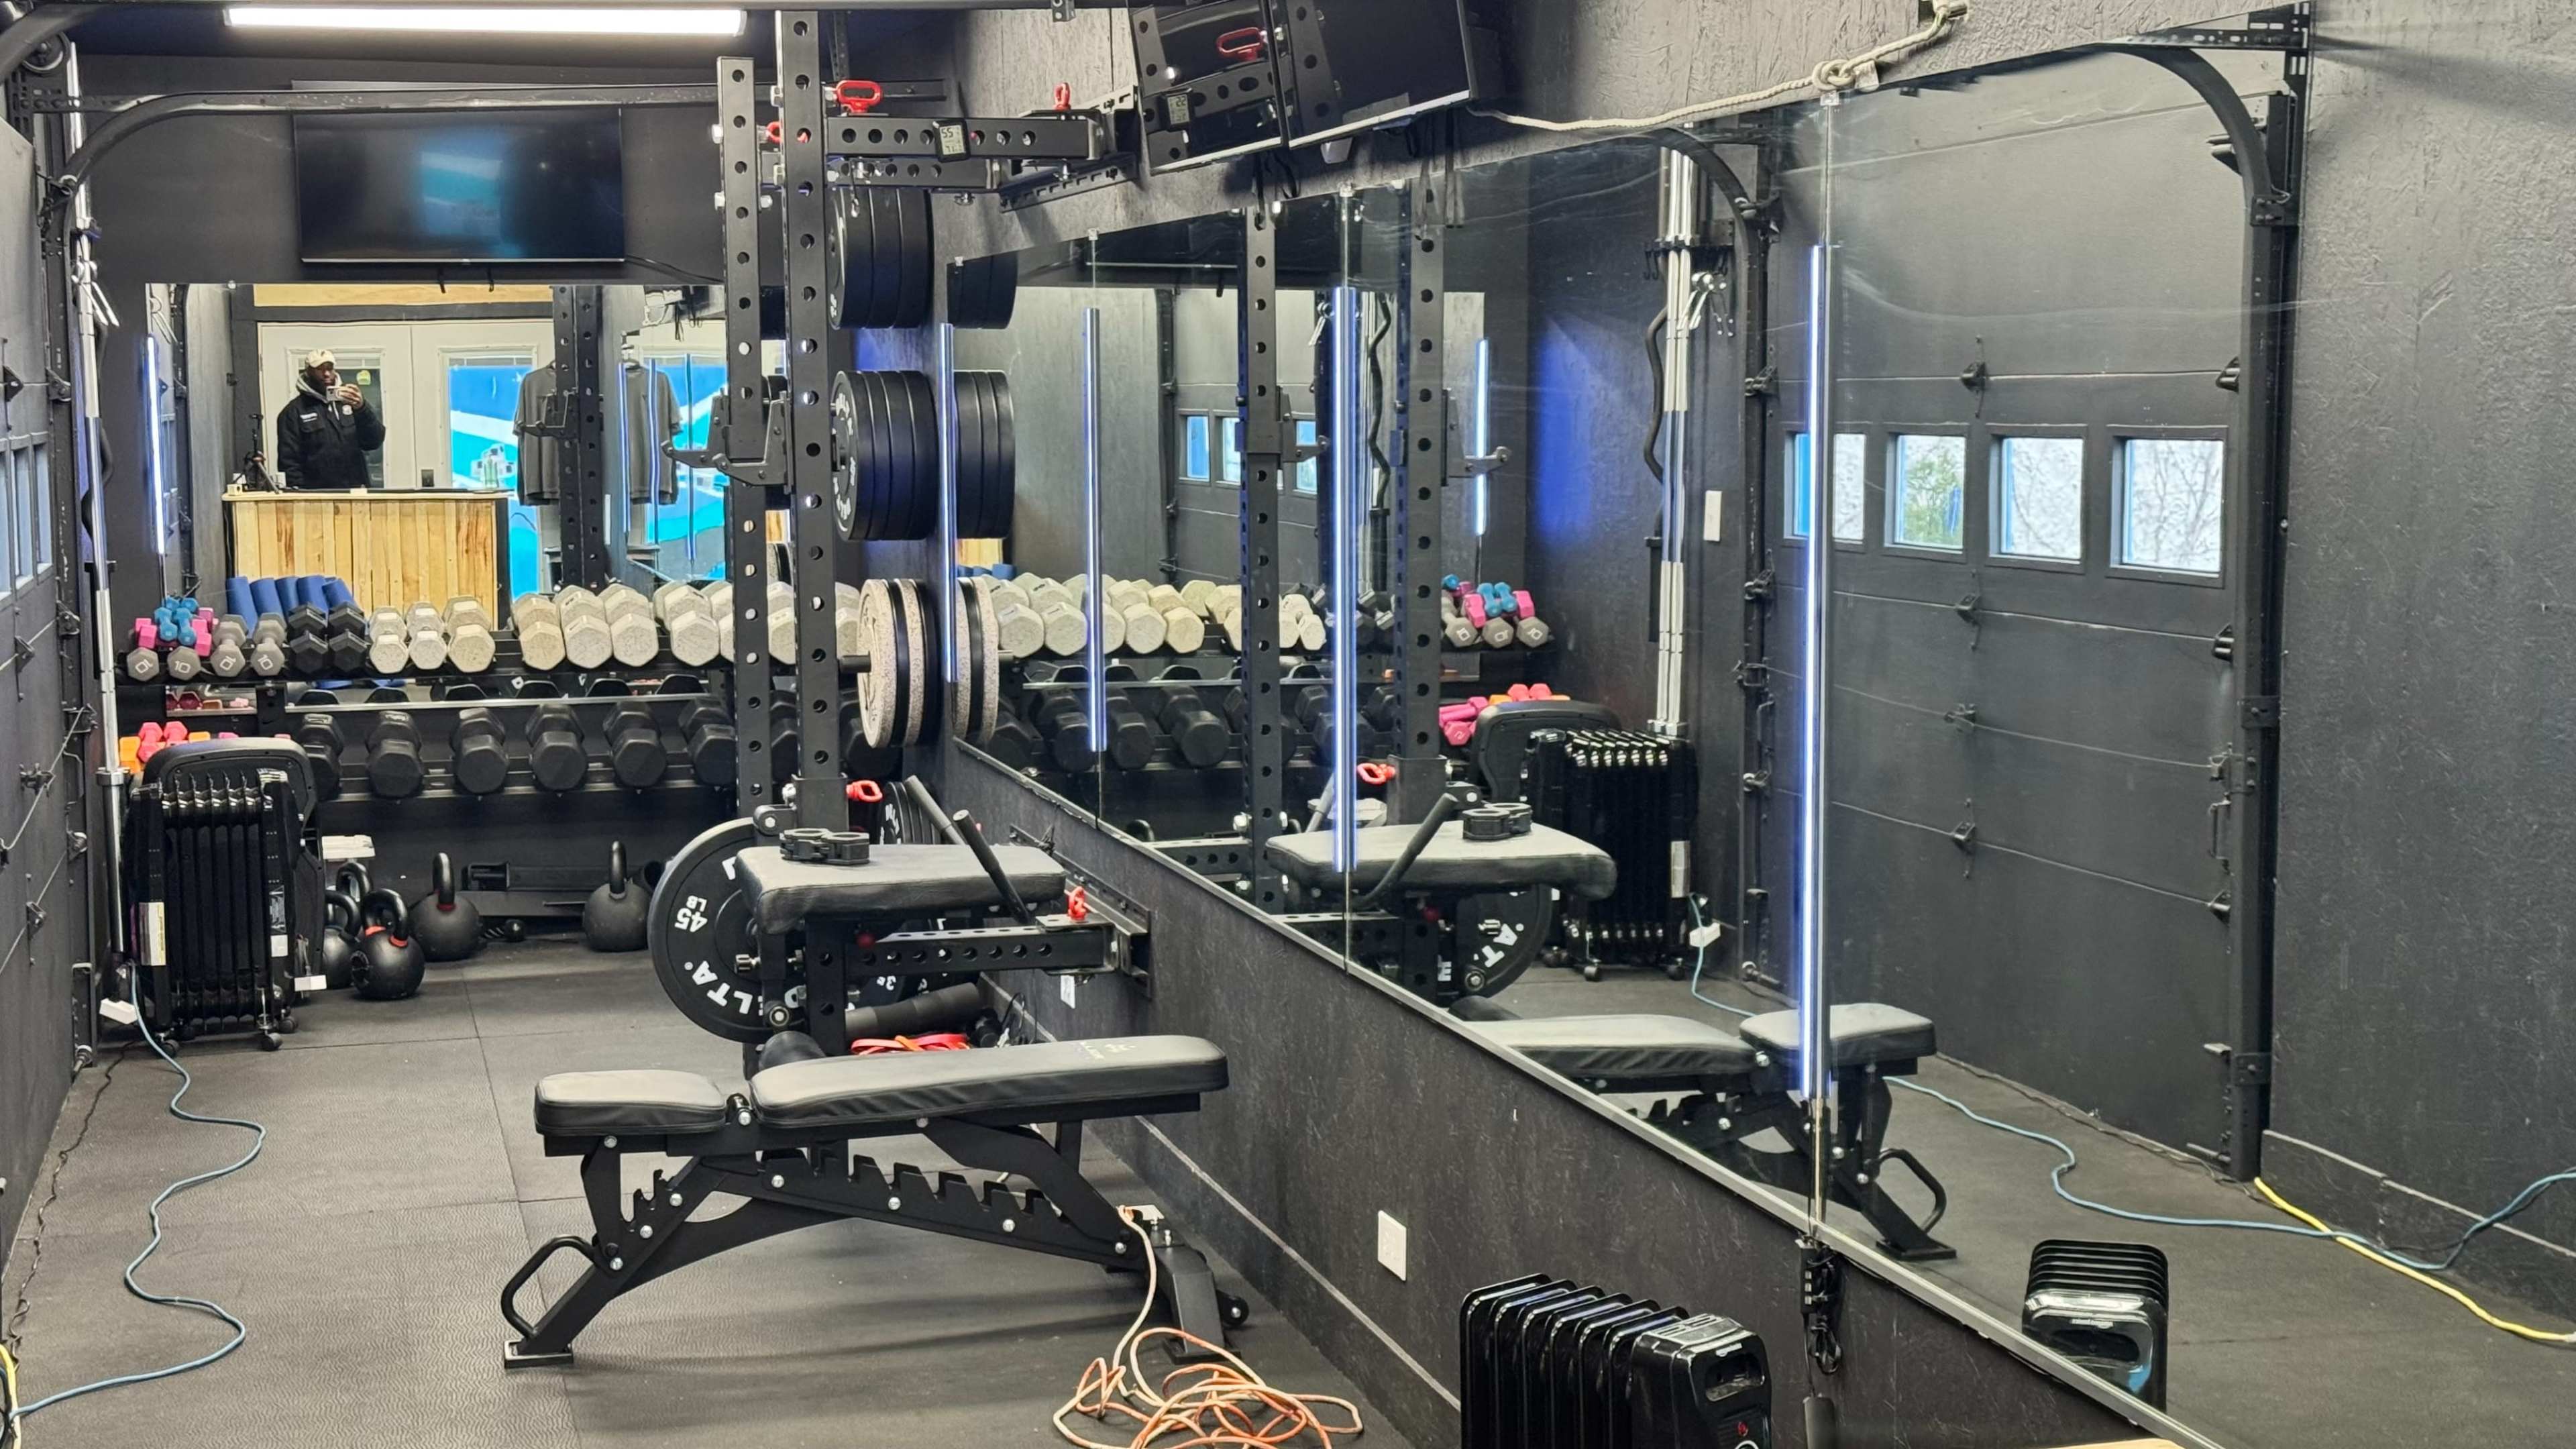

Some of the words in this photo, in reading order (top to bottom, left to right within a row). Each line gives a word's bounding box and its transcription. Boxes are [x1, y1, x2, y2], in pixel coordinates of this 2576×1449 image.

[941, 127, 953, 138] 55
[136, 659, 153, 674] 10
[174, 661, 191, 673] 10
[219, 655, 236, 670] 10
[258, 655, 273, 669] 10
[686, 895, 707, 912] LB
[674, 908, 708, 932] 45
[692, 960, 800, 1016] DLTA
